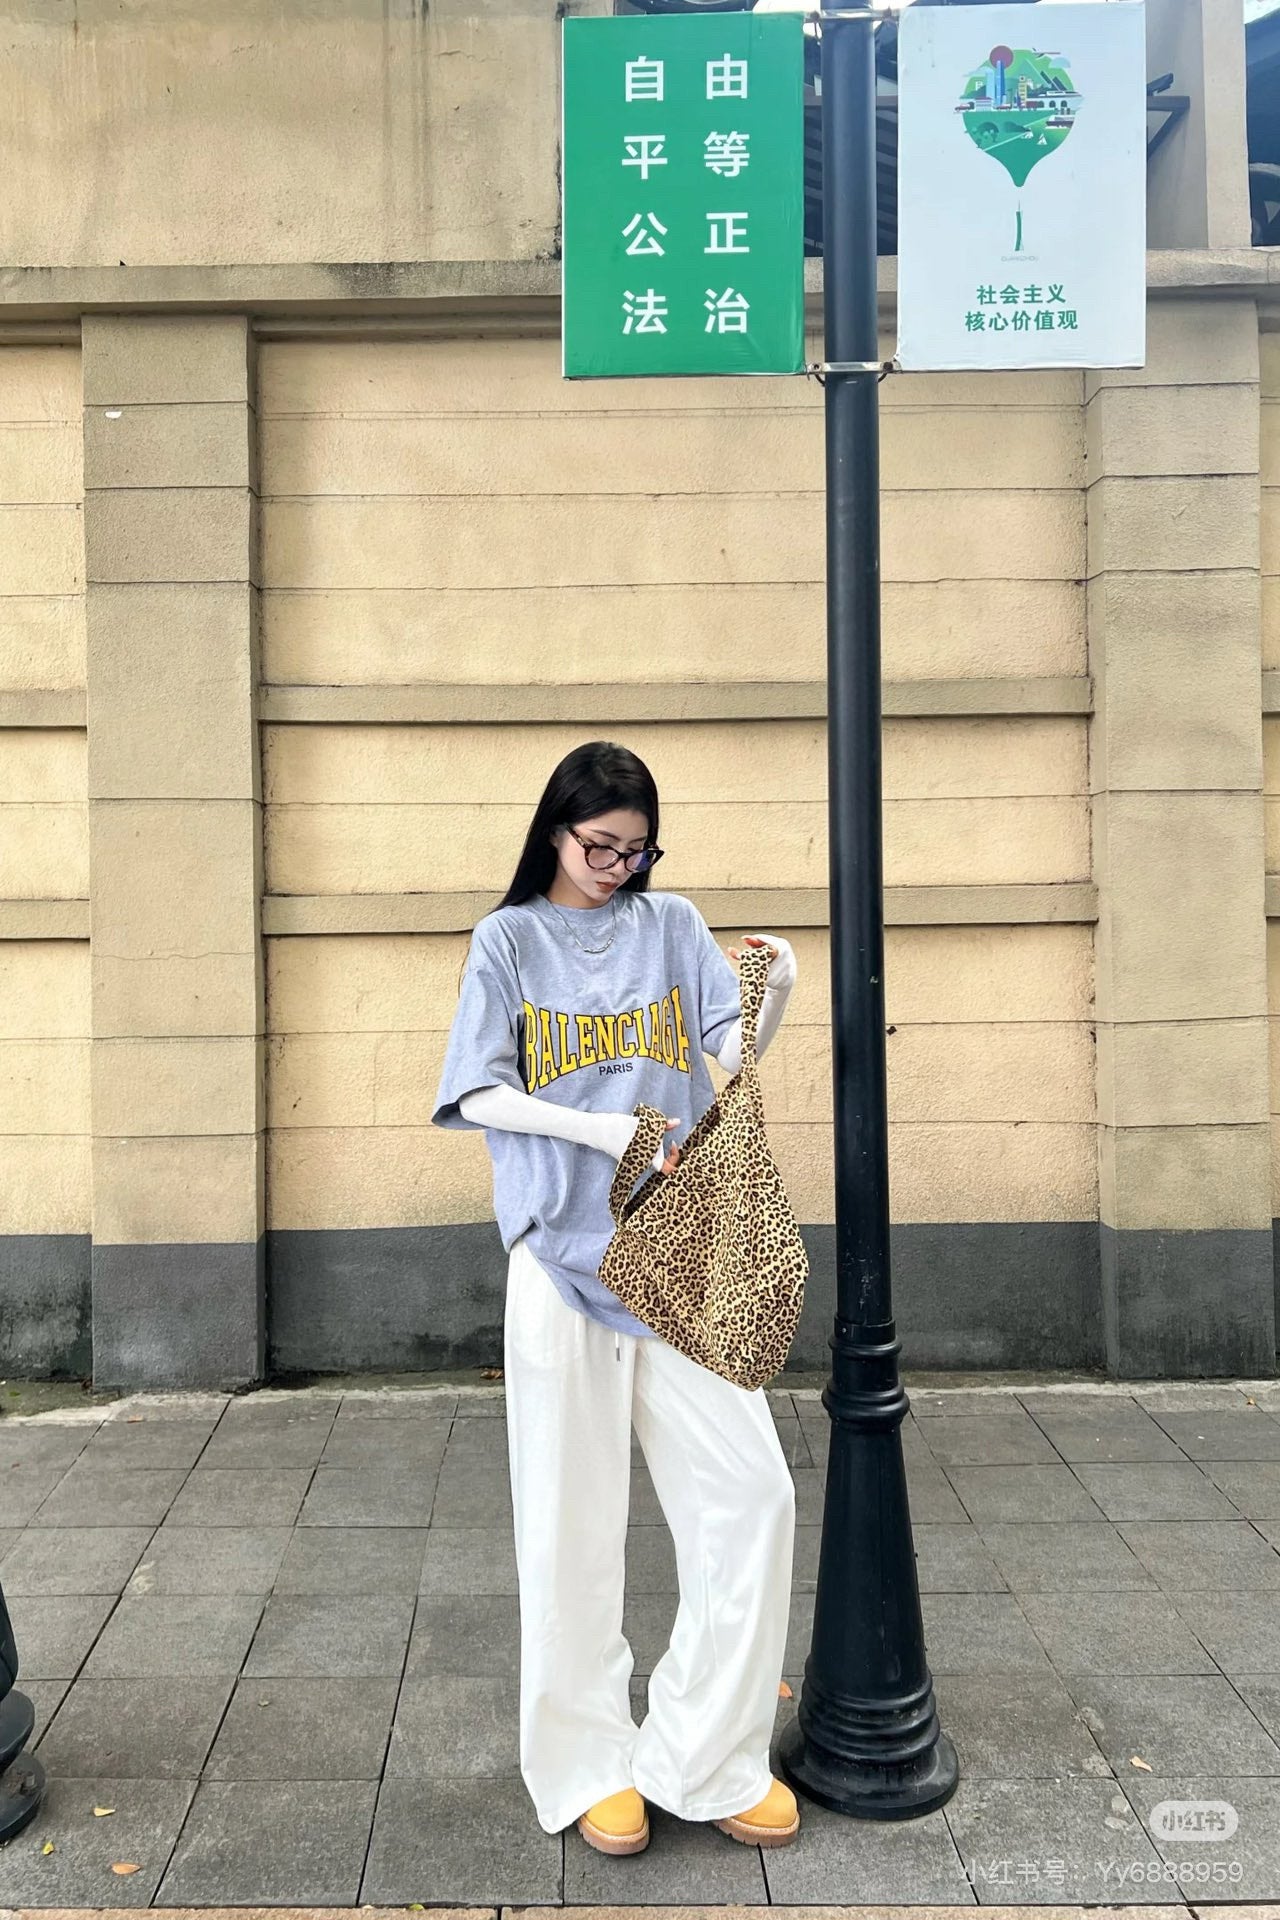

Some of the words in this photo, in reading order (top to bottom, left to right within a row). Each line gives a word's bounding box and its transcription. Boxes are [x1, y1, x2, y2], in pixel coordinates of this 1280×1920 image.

[624, 53, 748, 102] 自由
[621, 130, 750, 179] 平等
[621, 211, 750, 257] 公正
[622, 287, 750, 335] 法治
[976, 283, 1066, 305] 社会主义
[964, 309, 1079, 332] 核心价值观
[522, 985, 693, 1096] BALENCIAGA
[598, 1061, 634, 1076] PARIS
